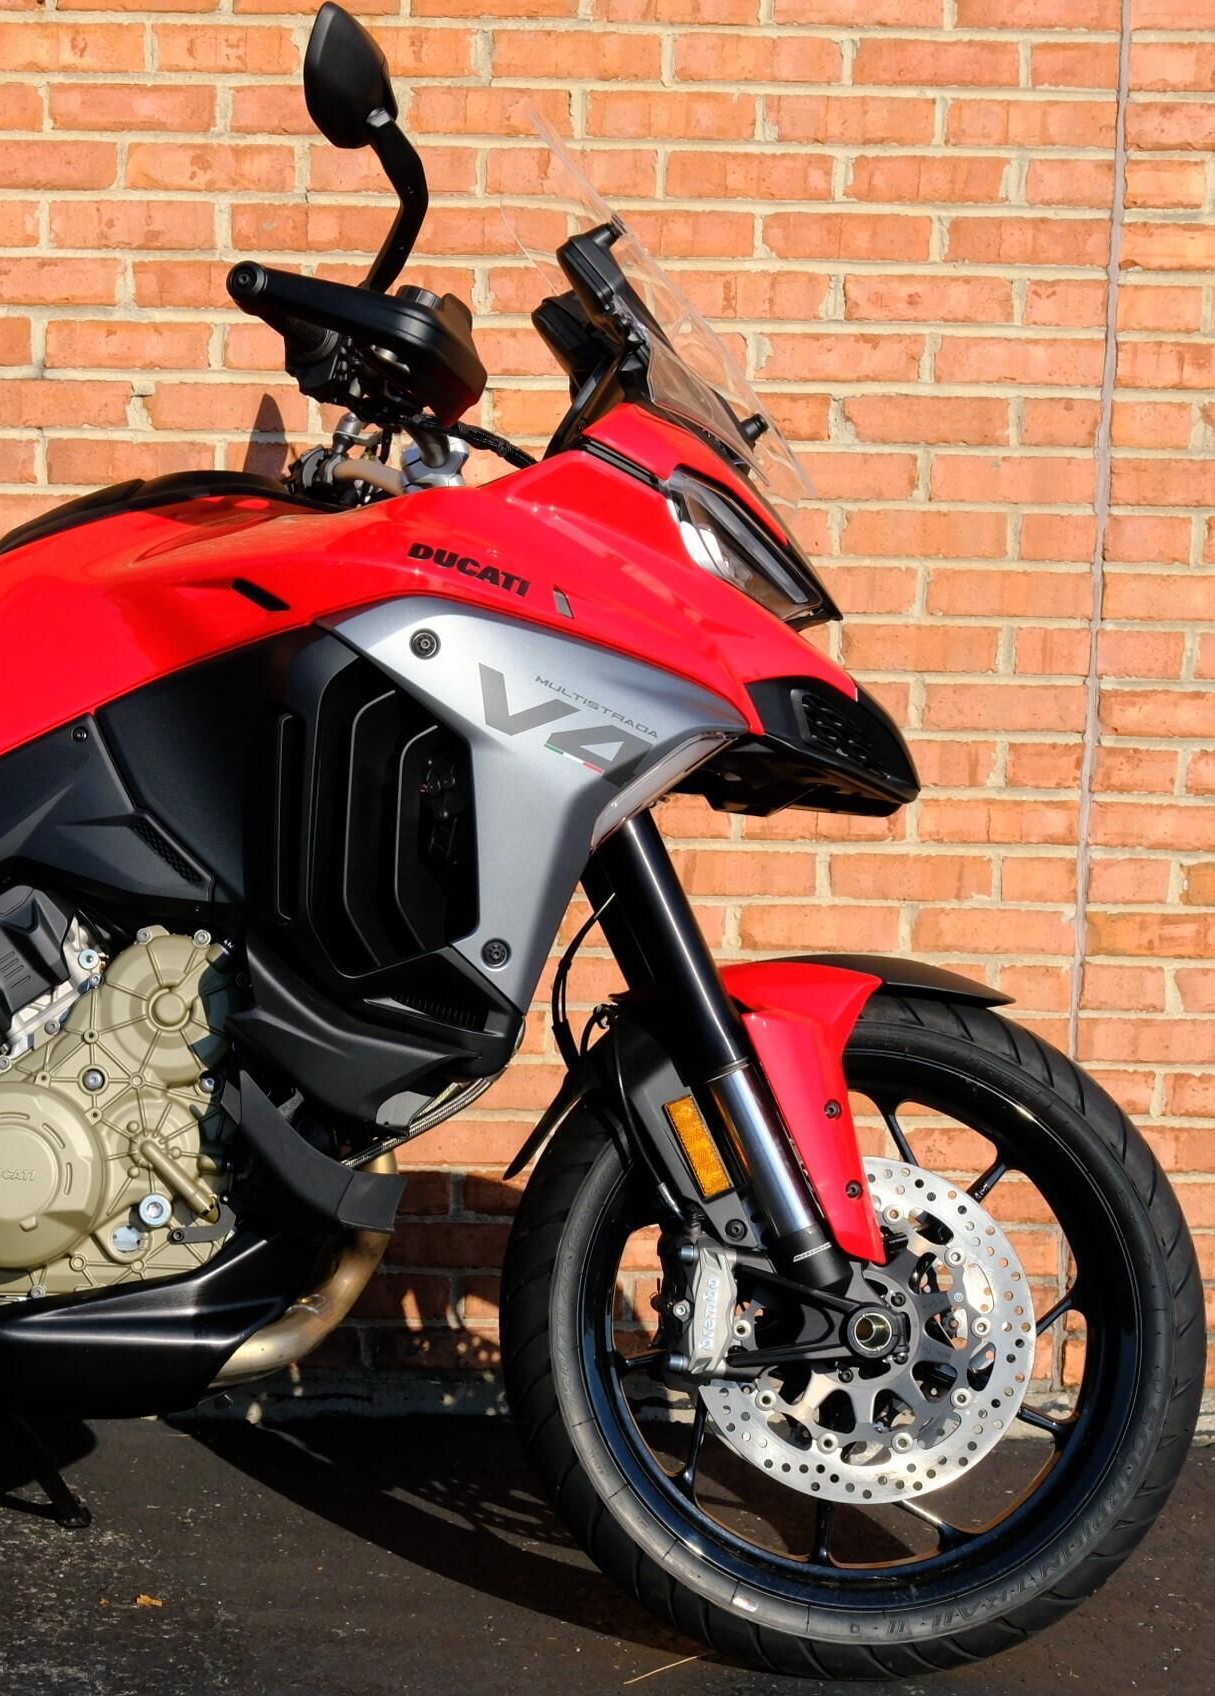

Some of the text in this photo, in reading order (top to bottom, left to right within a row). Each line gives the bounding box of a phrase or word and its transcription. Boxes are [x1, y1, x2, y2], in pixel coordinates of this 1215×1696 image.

[408, 543, 531, 597] DUCATI
[479, 661, 656, 788] V4
[535, 675, 660, 739] MULTISTRADA
[698, 1277, 720, 1351] brembo
